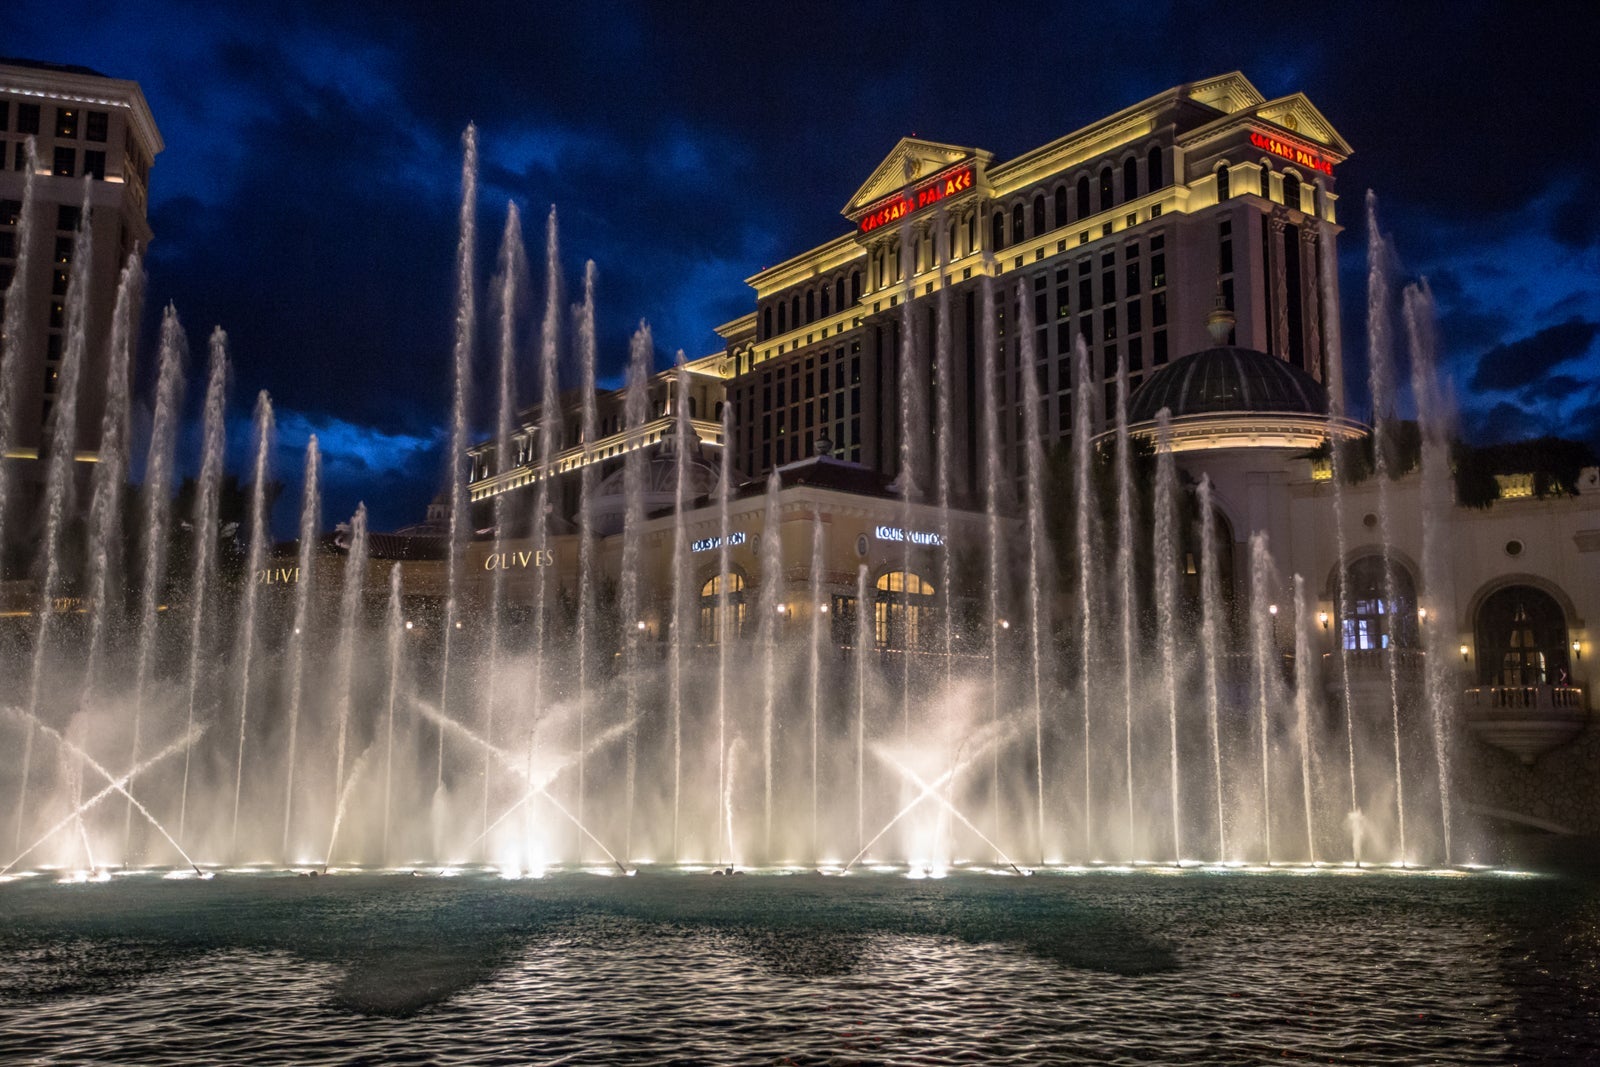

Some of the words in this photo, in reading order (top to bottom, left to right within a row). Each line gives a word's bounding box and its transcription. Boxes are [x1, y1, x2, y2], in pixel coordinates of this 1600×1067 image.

[1250, 132, 1294, 160] CAESARS
[1296, 150, 1332, 176] PALACE
[861, 197, 915, 233] CAESARS
[918, 171, 971, 209] PALACE
[875, 525, 904, 542] LOUIS
